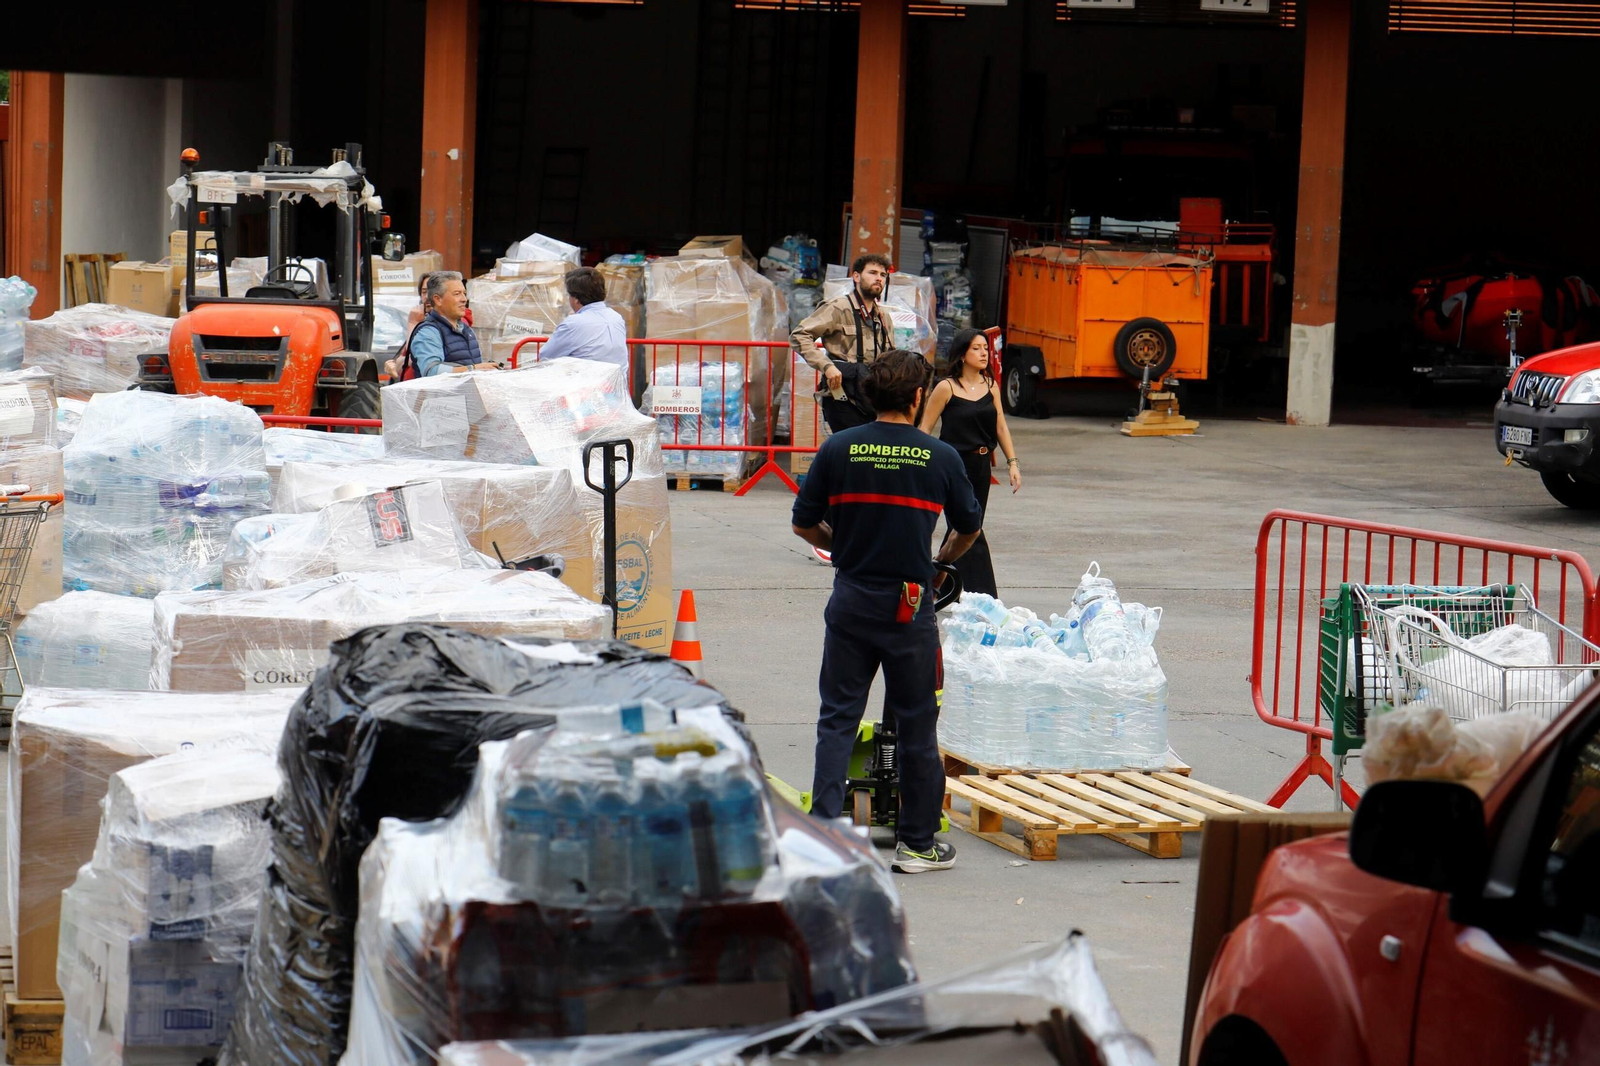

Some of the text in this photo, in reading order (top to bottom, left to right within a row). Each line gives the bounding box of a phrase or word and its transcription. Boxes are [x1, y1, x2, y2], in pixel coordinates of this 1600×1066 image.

[654, 405, 700, 413] BOMBEROS
[849, 443, 931, 460] BOMBEROS
[888, 458, 928, 467] PROVINCIAL
[645, 627, 664, 638] LECHE
